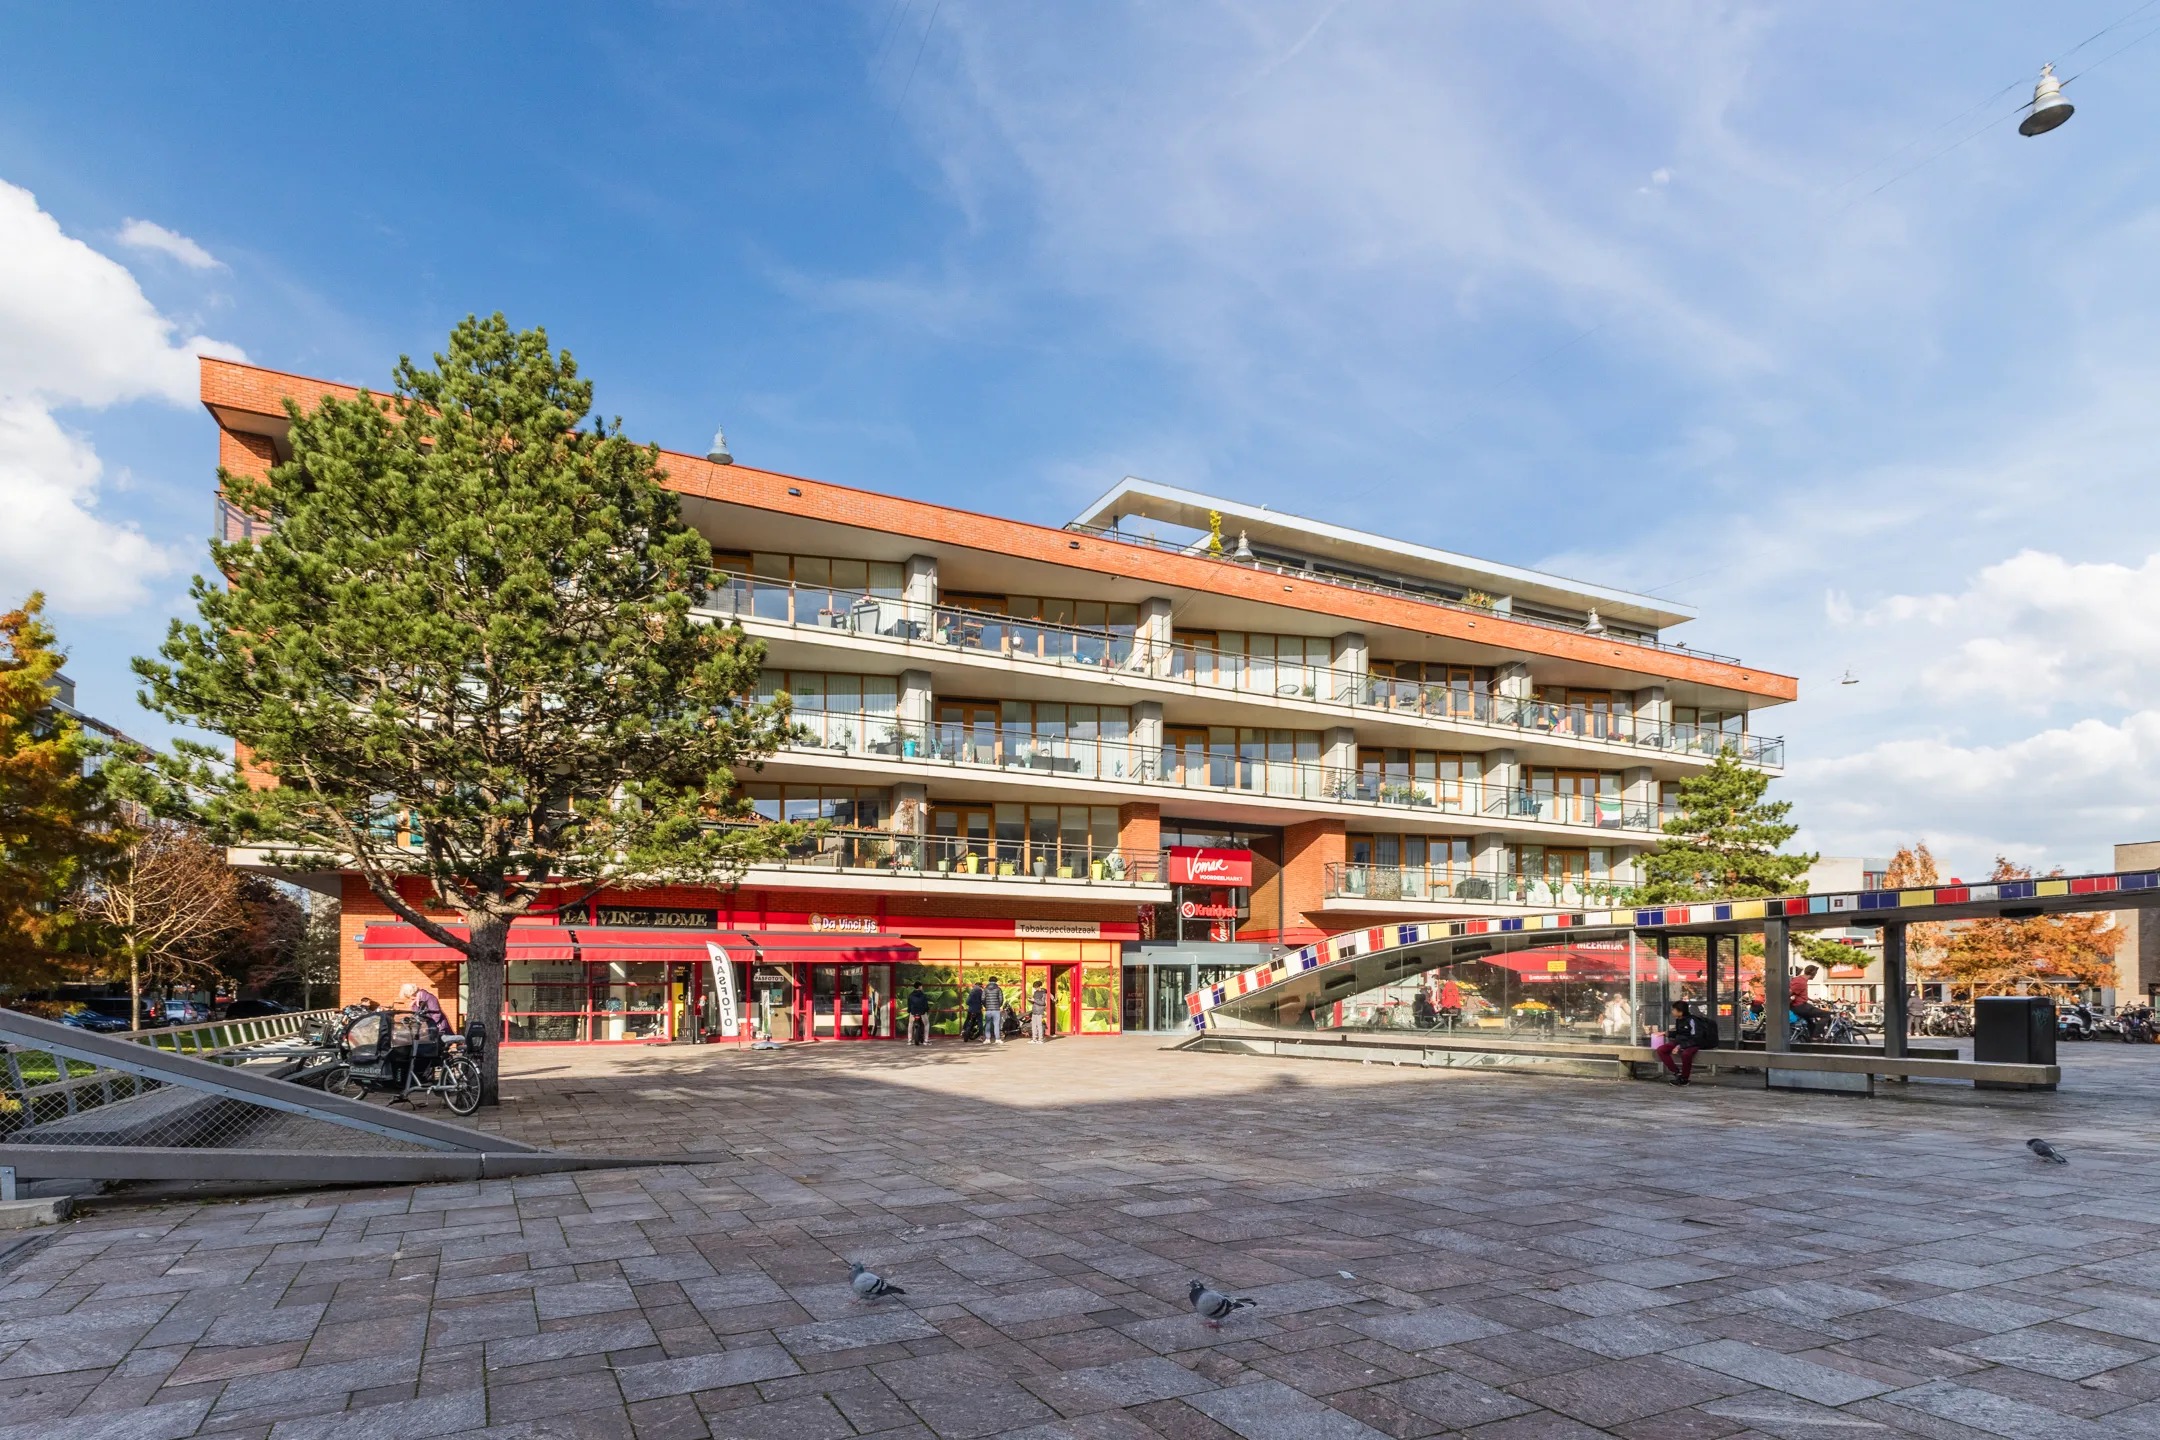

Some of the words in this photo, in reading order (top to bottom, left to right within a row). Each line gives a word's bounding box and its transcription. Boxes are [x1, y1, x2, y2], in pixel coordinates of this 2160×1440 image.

[1187, 849, 1228, 881] Vomar
[1195, 904, 1237, 917] Kruidvat
[654, 912, 708, 927] HOME
[823, 918, 836, 929] Da
[839, 919, 861, 930] Vinci
[1020, 924, 1096, 935] Tabakspeciaalzaak
